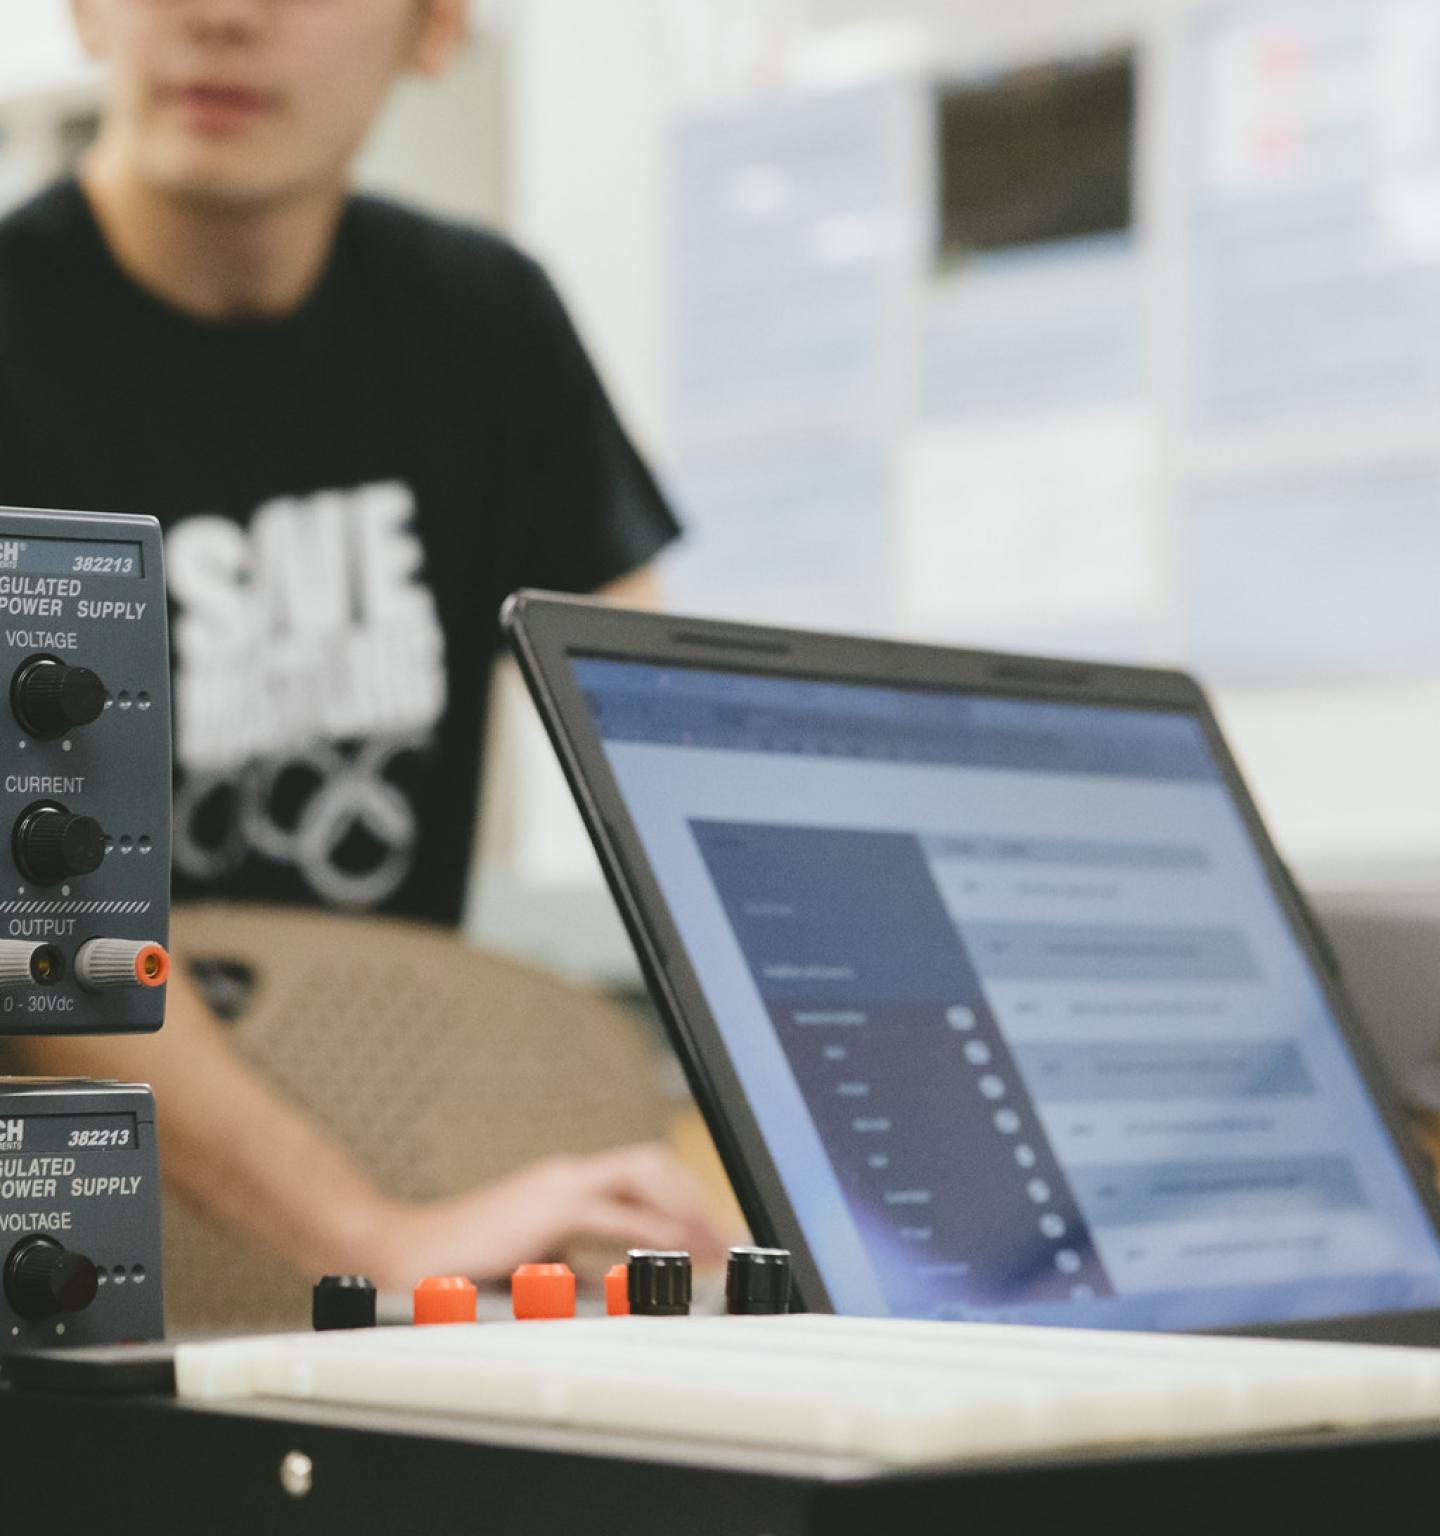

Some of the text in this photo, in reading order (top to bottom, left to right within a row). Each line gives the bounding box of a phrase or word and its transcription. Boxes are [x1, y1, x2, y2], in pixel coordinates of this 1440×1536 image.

[72, 555, 133, 573] 382213
[76, 600, 146, 620] SUPPLY
[5, 630, 78, 649] VOLTAGE
[5, 775, 85, 793] CURRENT
[9, 918, 76, 936] OUTPUT
[4, 997, 13, 1012] 0
[28, 996, 74, 1012] 30Vdc
[68, 1129, 130, 1147] 382213
[70, 1176, 142, 1196] SUPPLY
